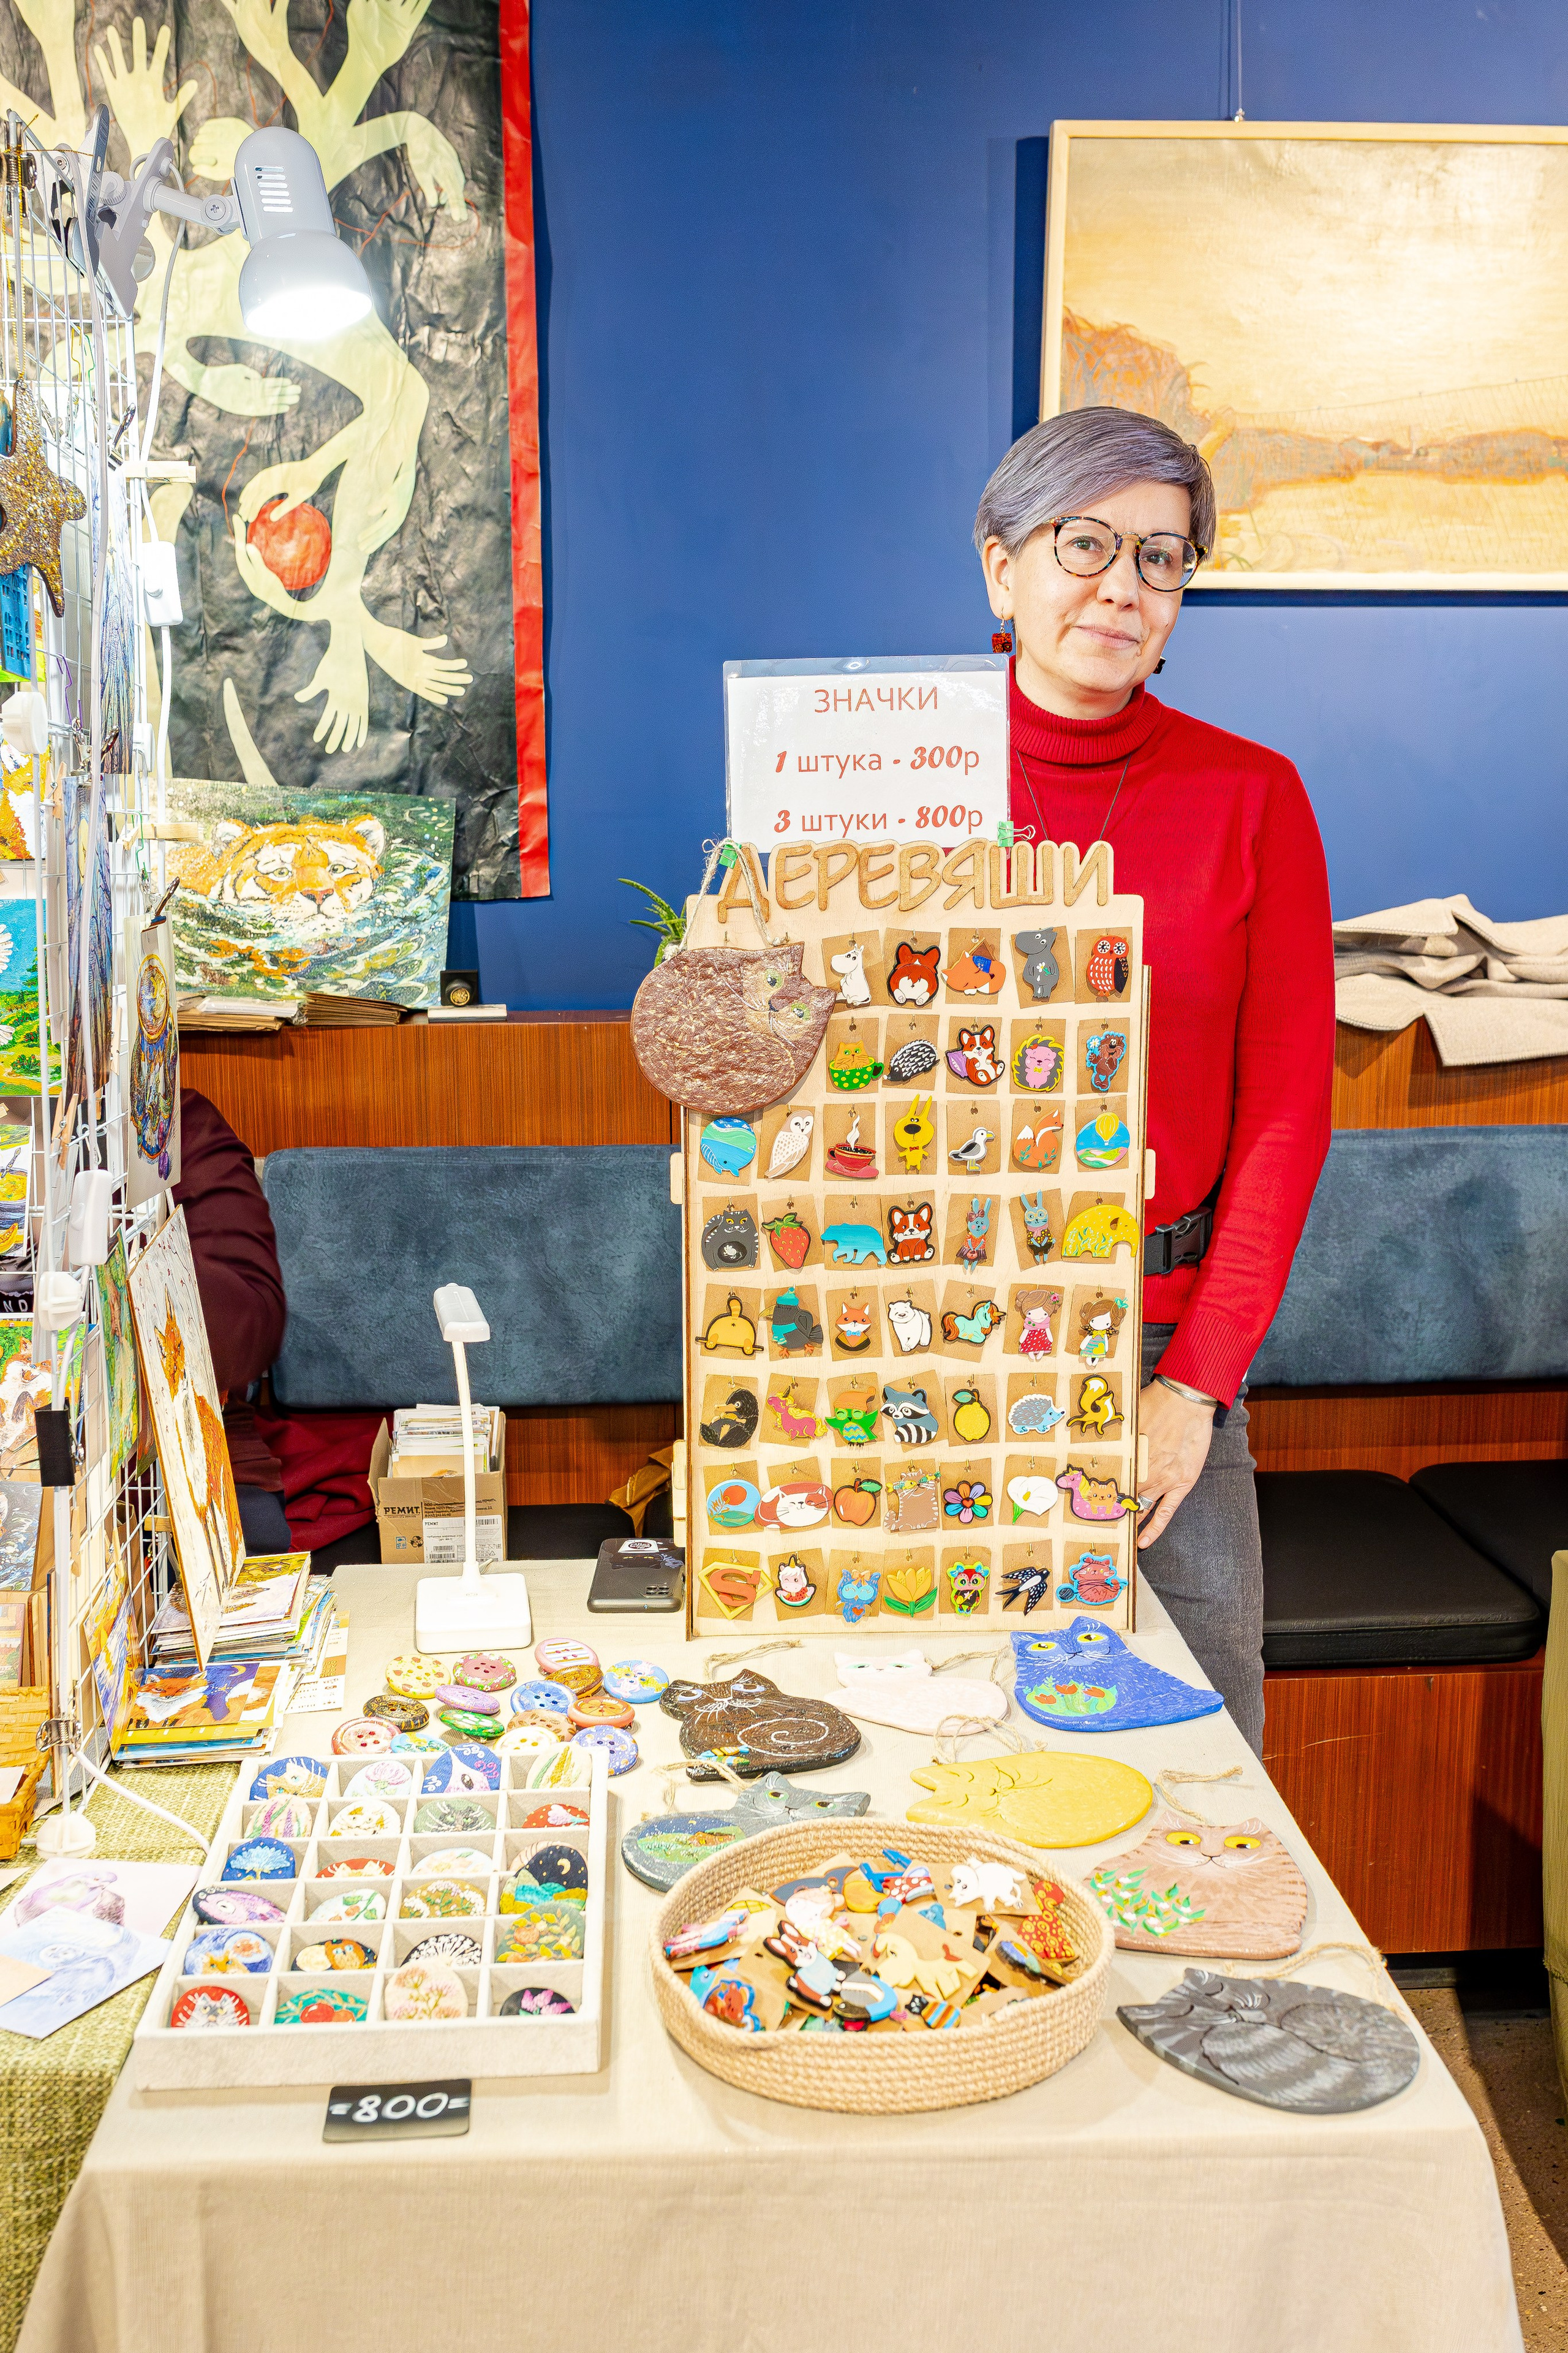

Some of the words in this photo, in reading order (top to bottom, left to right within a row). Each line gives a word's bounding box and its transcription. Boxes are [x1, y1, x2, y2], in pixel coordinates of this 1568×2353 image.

[814, 687, 938, 713] ЗНАЧКИ
[775, 750, 786, 773] 1
[797, 753, 882, 779] штука
[910, 746, 979, 776] 300р
[774, 809, 790, 833] 3
[801, 811, 887, 838] штуки
[915, 804, 982, 833] 800р
[718, 843, 1107, 923] ДЕРЕВЯШИ
